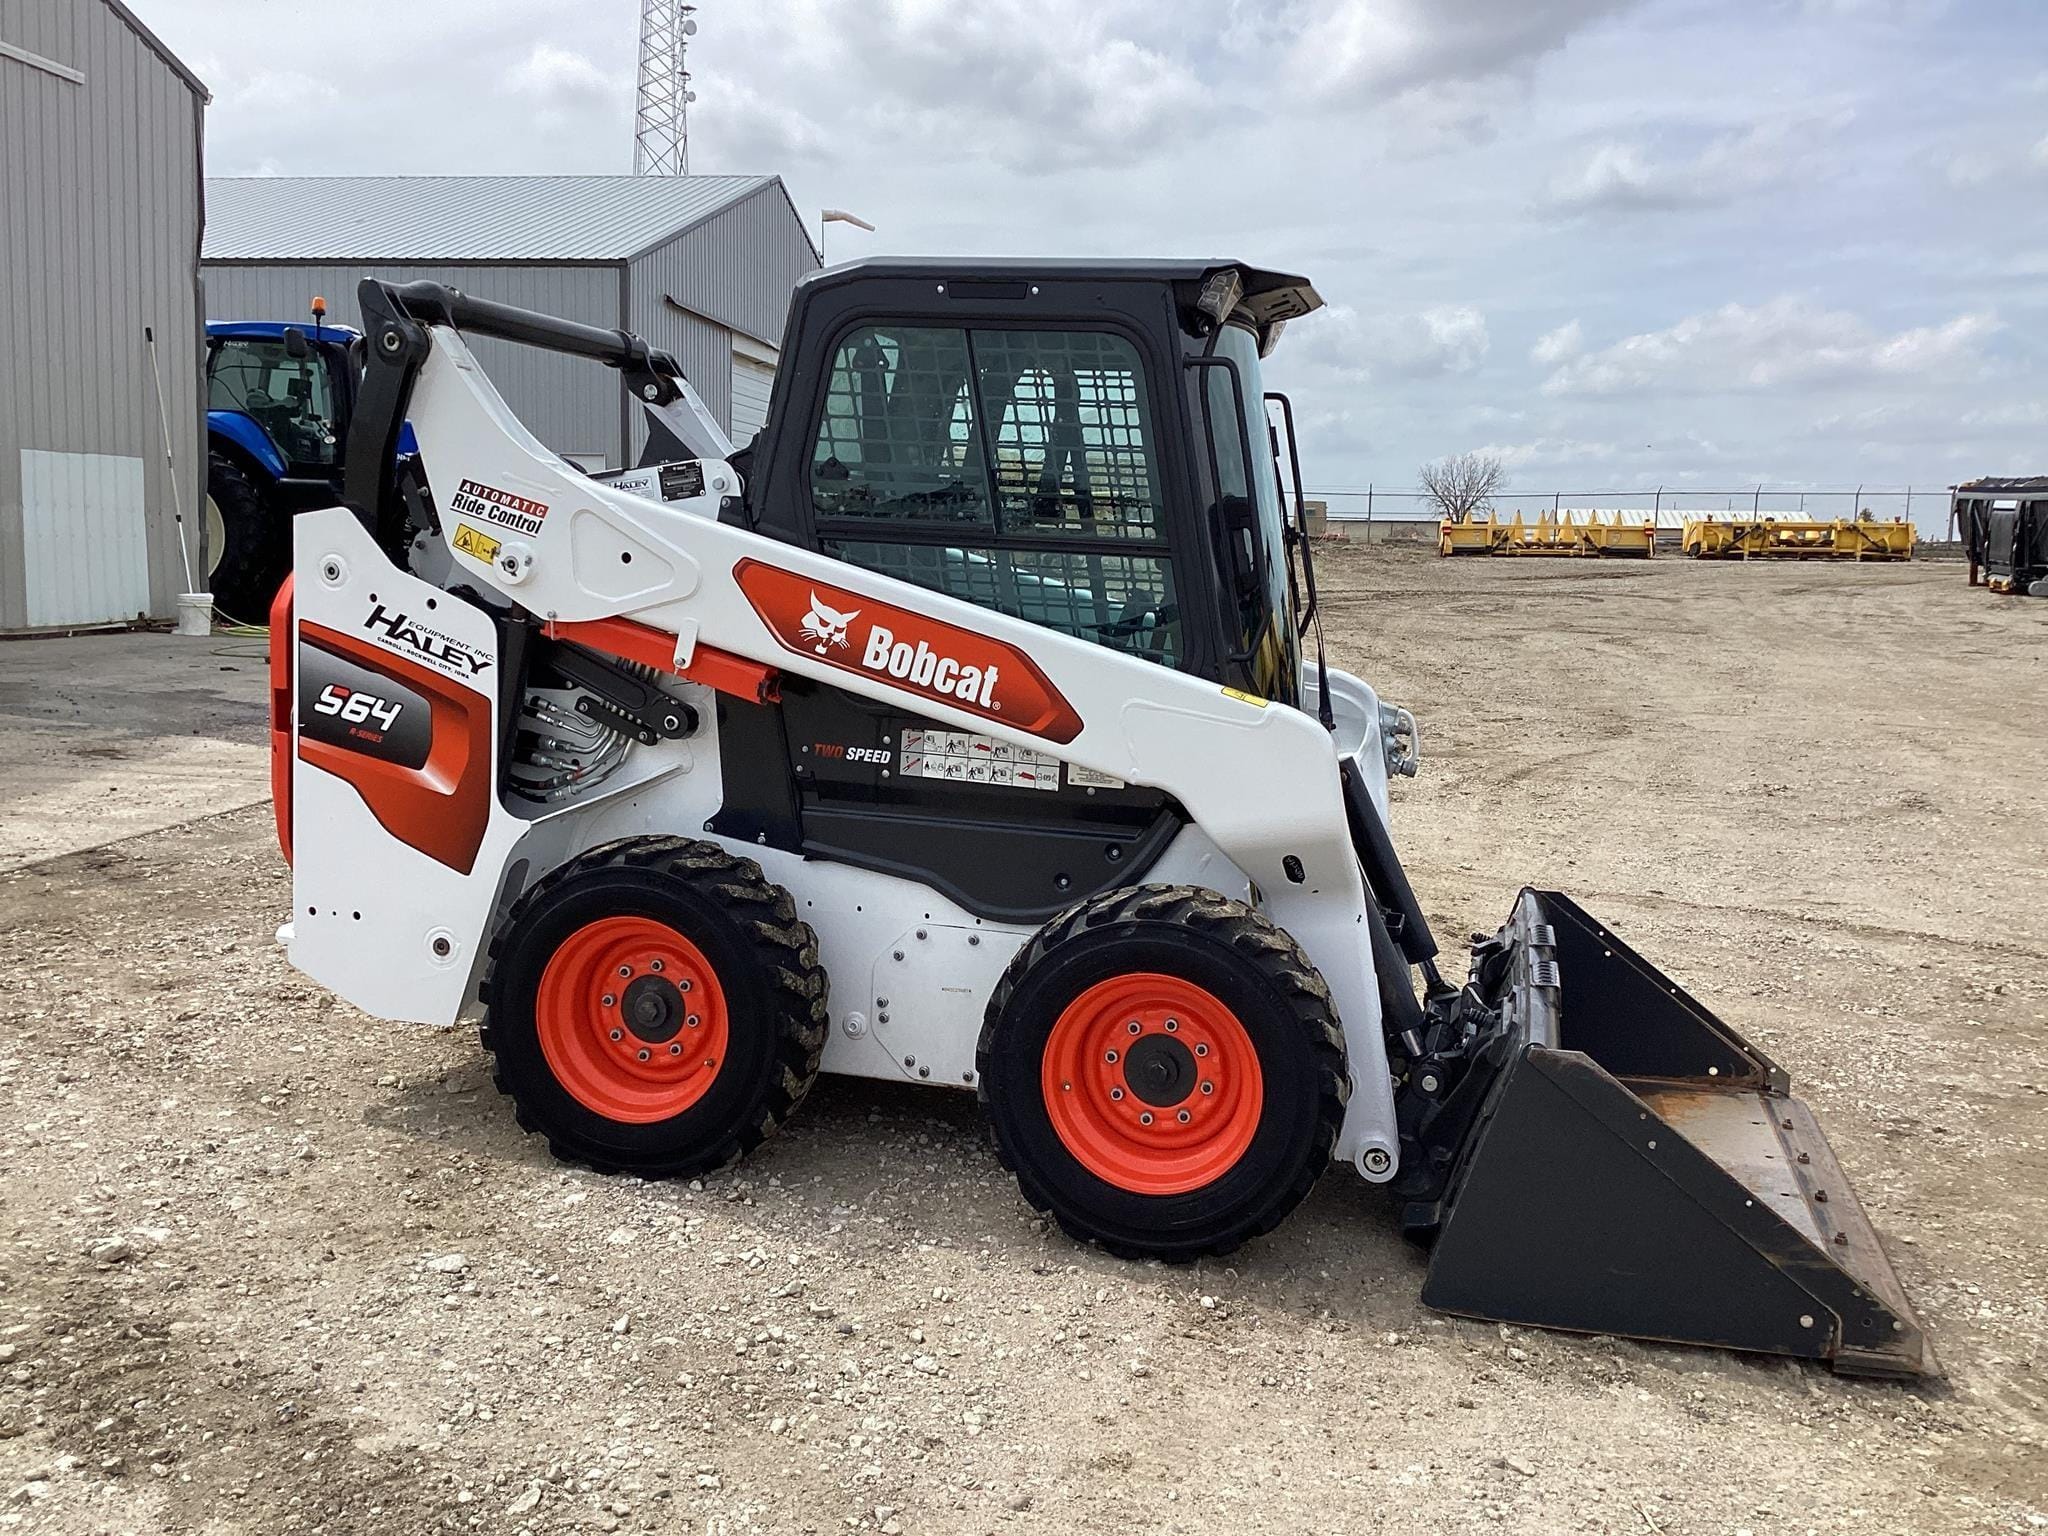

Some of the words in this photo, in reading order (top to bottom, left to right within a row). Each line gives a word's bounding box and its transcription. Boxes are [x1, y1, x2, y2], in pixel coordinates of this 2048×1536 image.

[451, 492, 486, 515] Ride
[487, 505, 543, 534] Control
[462, 482, 545, 516] AUTOMATIC
[363, 604, 493, 675] HALEY
[407, 620, 472, 651] EQUIPMENT
[377, 636, 402, 651] CARROLL
[406, 648, 437, 666] ROCKWELL
[454, 668, 470, 680] IOWA
[862, 624, 999, 708] Bobcat
[314, 684, 402, 731] S64
[814, 743, 844, 758] TWO
[845, 746, 892, 764] SPEED
